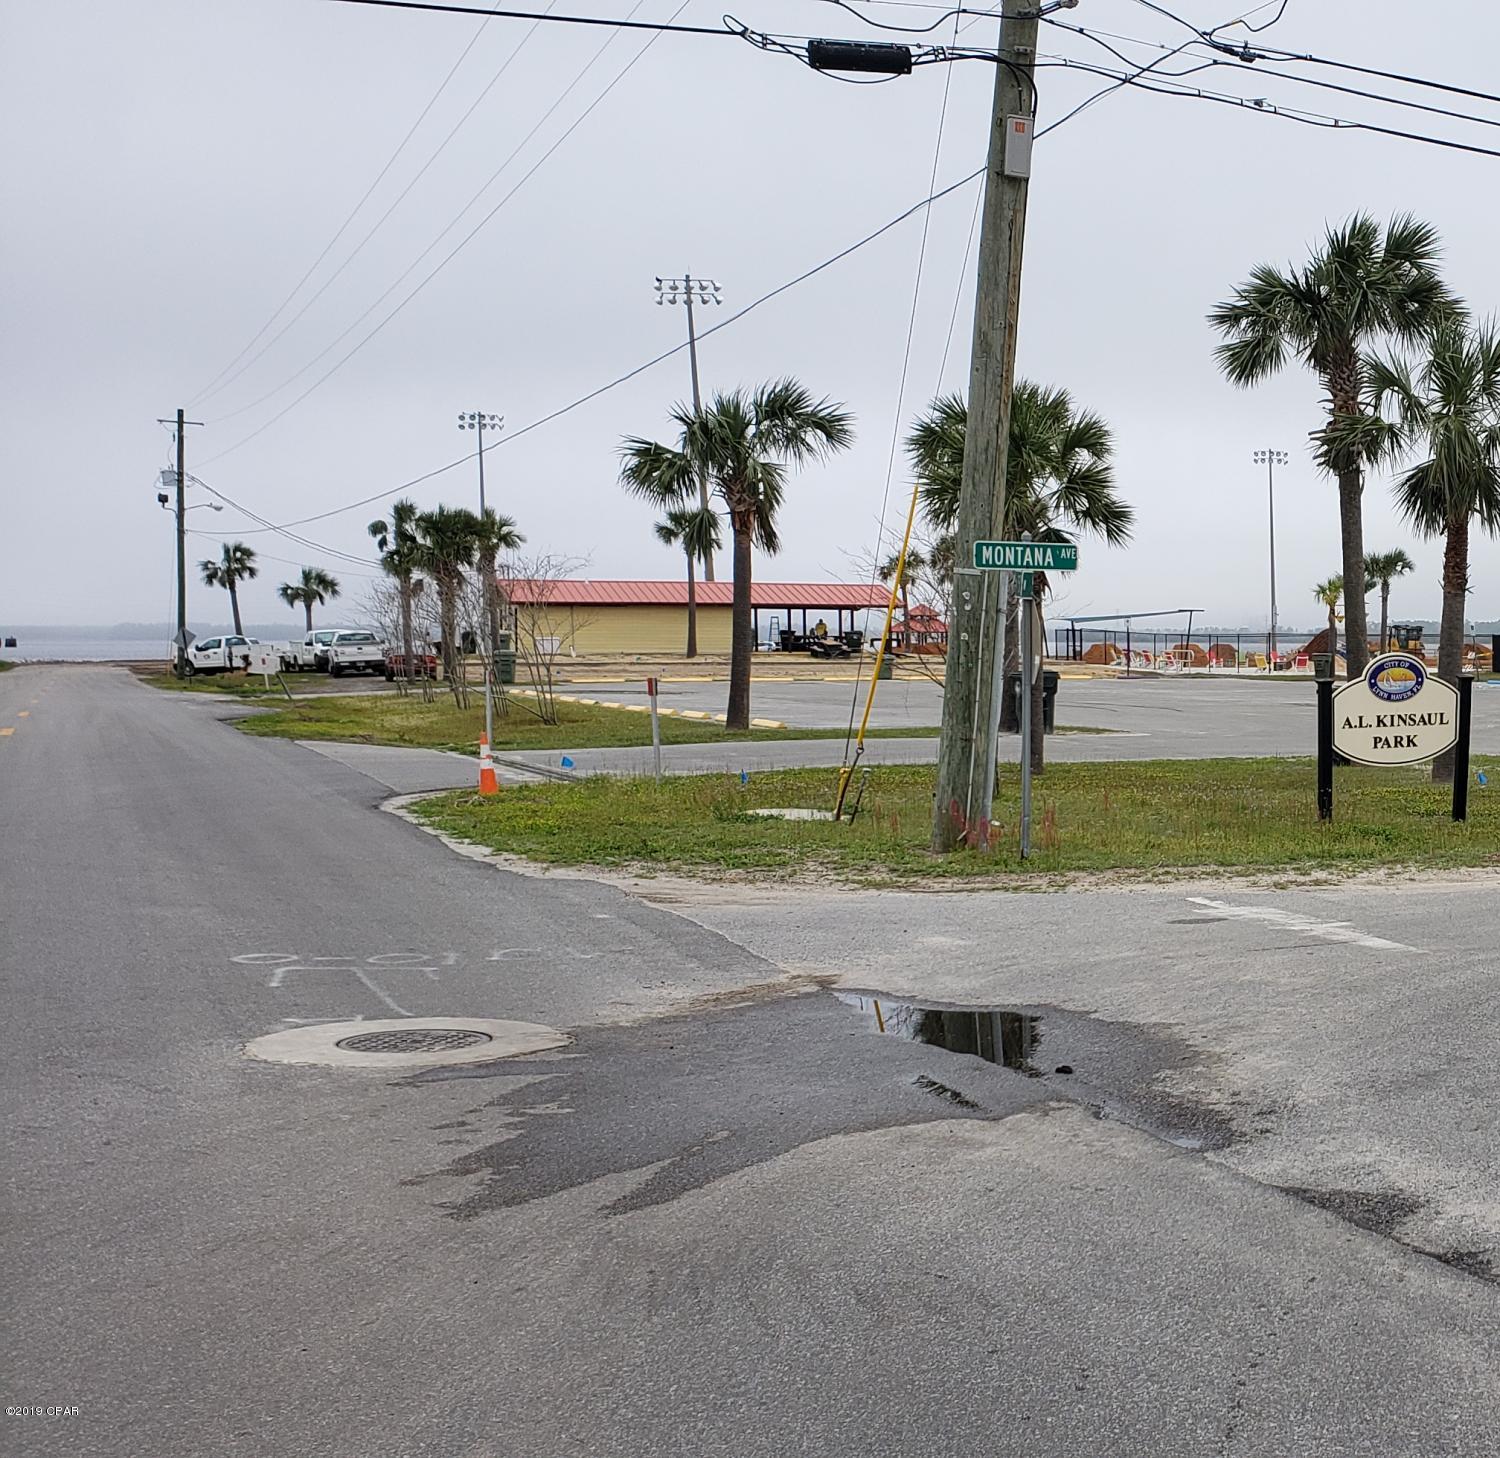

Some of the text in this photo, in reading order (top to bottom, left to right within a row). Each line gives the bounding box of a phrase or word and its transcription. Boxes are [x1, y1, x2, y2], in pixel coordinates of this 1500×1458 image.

[982, 545, 1077, 567] MONTANA AVE
[1384, 661, 1399, 669] CITY
[1373, 686, 1388, 699] LYNN
[1413, 684, 1421, 692] FL
[1342, 712, 1449, 729] A.L. KINSAUL
[1373, 735, 1418, 749] PARK
